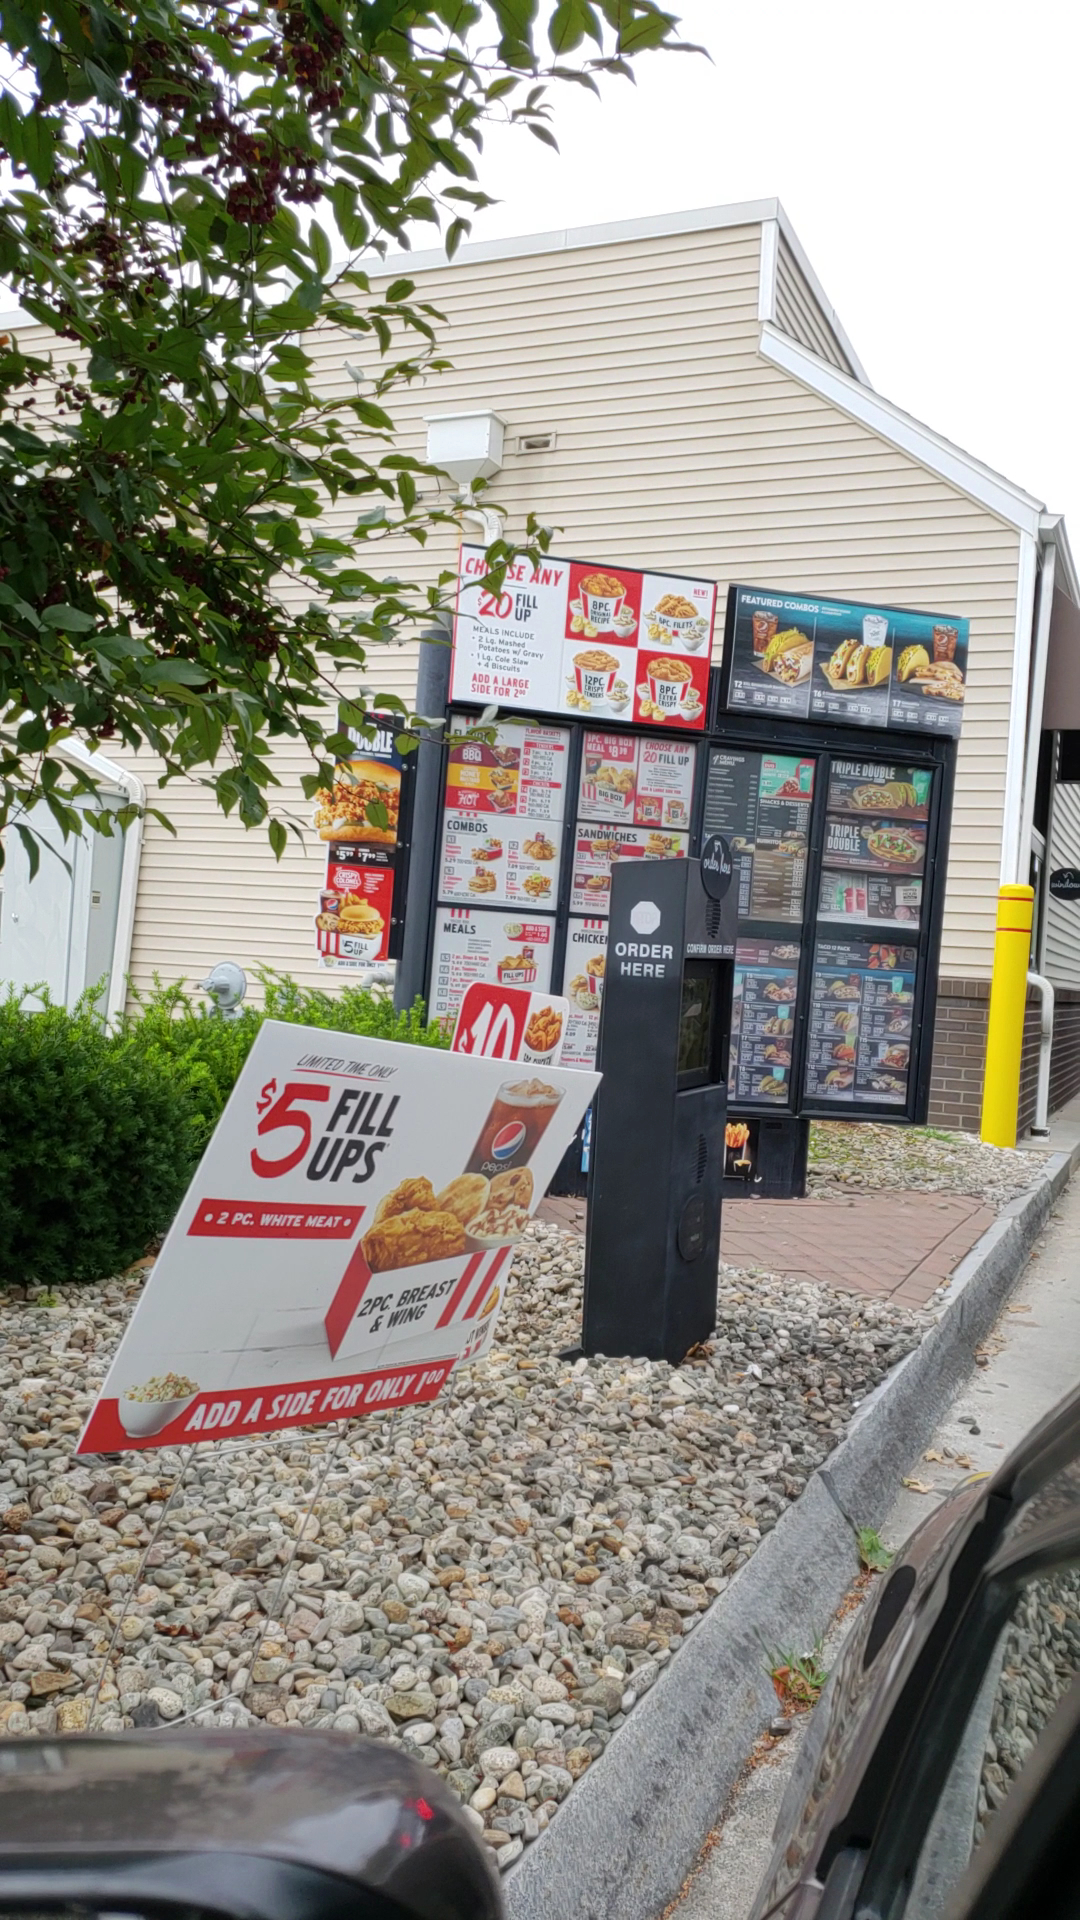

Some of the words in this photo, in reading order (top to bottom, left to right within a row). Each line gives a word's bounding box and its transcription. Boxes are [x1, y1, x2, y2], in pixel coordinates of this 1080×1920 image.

[465, 557, 526, 582] CHSE
[529, 567, 564, 587] ANY
[477, 589, 513, 619] $20
[515, 593, 538, 609] FILL
[592, 601, 610, 611] 8PC.
[741, 595, 783, 608] FEATURED
[784, 601, 819, 613] COMBOS
[514, 607, 531, 622] UP
[590, 615, 610, 624] RECIPE
[473, 625, 499, 635] MEALS
[502, 629, 535, 640] INCLUDE
[499, 639, 525, 648] Mashed
[478, 644, 510, 654] Potatoes
[523, 650, 544, 660] Gravy
[495, 655, 510, 663] Cole
[512, 657, 529, 665] Slaw
[491, 662, 520, 672] Biscuits
[471, 673, 490, 683] ADD
[493, 676, 499, 685] A
[501, 677, 530, 688] LARGE
[584, 674, 605, 686] 12PC.
[734, 680, 743, 688] T2
[471, 684, 491, 694] SIDE
[493, 686, 510, 697] FOR
[584, 685, 604, 693] CRISPY
[584, 690, 604, 699] TENDERS
[659, 684, 678, 695] 8PC.
[813, 690, 822, 698] T6
[658, 699, 677, 708] CRISPY
[659, 693, 677, 701] EXTRA
[645, 742, 673, 752] CHOOSE
[674, 745, 690, 754] ANY
[658, 754, 676, 764] FILL
[678, 756, 689, 766] UP
[831, 761, 861, 776] TRIPLE
[862, 764, 896, 779] DOUBLE
[447, 820, 488, 833] COMBOS
[829, 824, 860, 838] TRIPLE
[578, 828, 638, 843] SANDWICHES
[827, 836, 860, 852] DOUBLE
[443, 923, 476, 934] MEALS
[353, 942, 368, 950] FILL
[615, 942, 674, 959] ORDER
[687, 943, 707, 953] CONFIRM
[708, 944, 722, 953] ORDER
[723, 945, 734, 954] HERE
[620, 961, 666, 978] HERE
[297, 1053, 345, 1071] LIMITED
[344, 1061, 372, 1075] TIME
[368, 1065, 399, 1078] ONLY
[251, 1077, 331, 1179] $5
[325, 1088, 401, 1137] FILL
[306, 1136, 387, 1183] UPS
[480, 1161, 512, 1173] pepsi
[216, 1212, 230, 1224] 2
[231, 1212, 255, 1226] PC.
[260, 1213, 304, 1227] WHITE
[304, 1215, 342, 1228] MEAT
[357, 1294, 391, 1318] 2PC.
[397, 1278, 458, 1306] BREAST
[369, 1317, 386, 1333] &
[387, 1304, 428, 1328] WING
[183, 1400, 242, 1432] ADD
[242, 1397, 263, 1425] A
[265, 1389, 322, 1420] SIDE
[319, 1383, 365, 1412] FOR
[364, 1373, 417, 1403] ONLY
